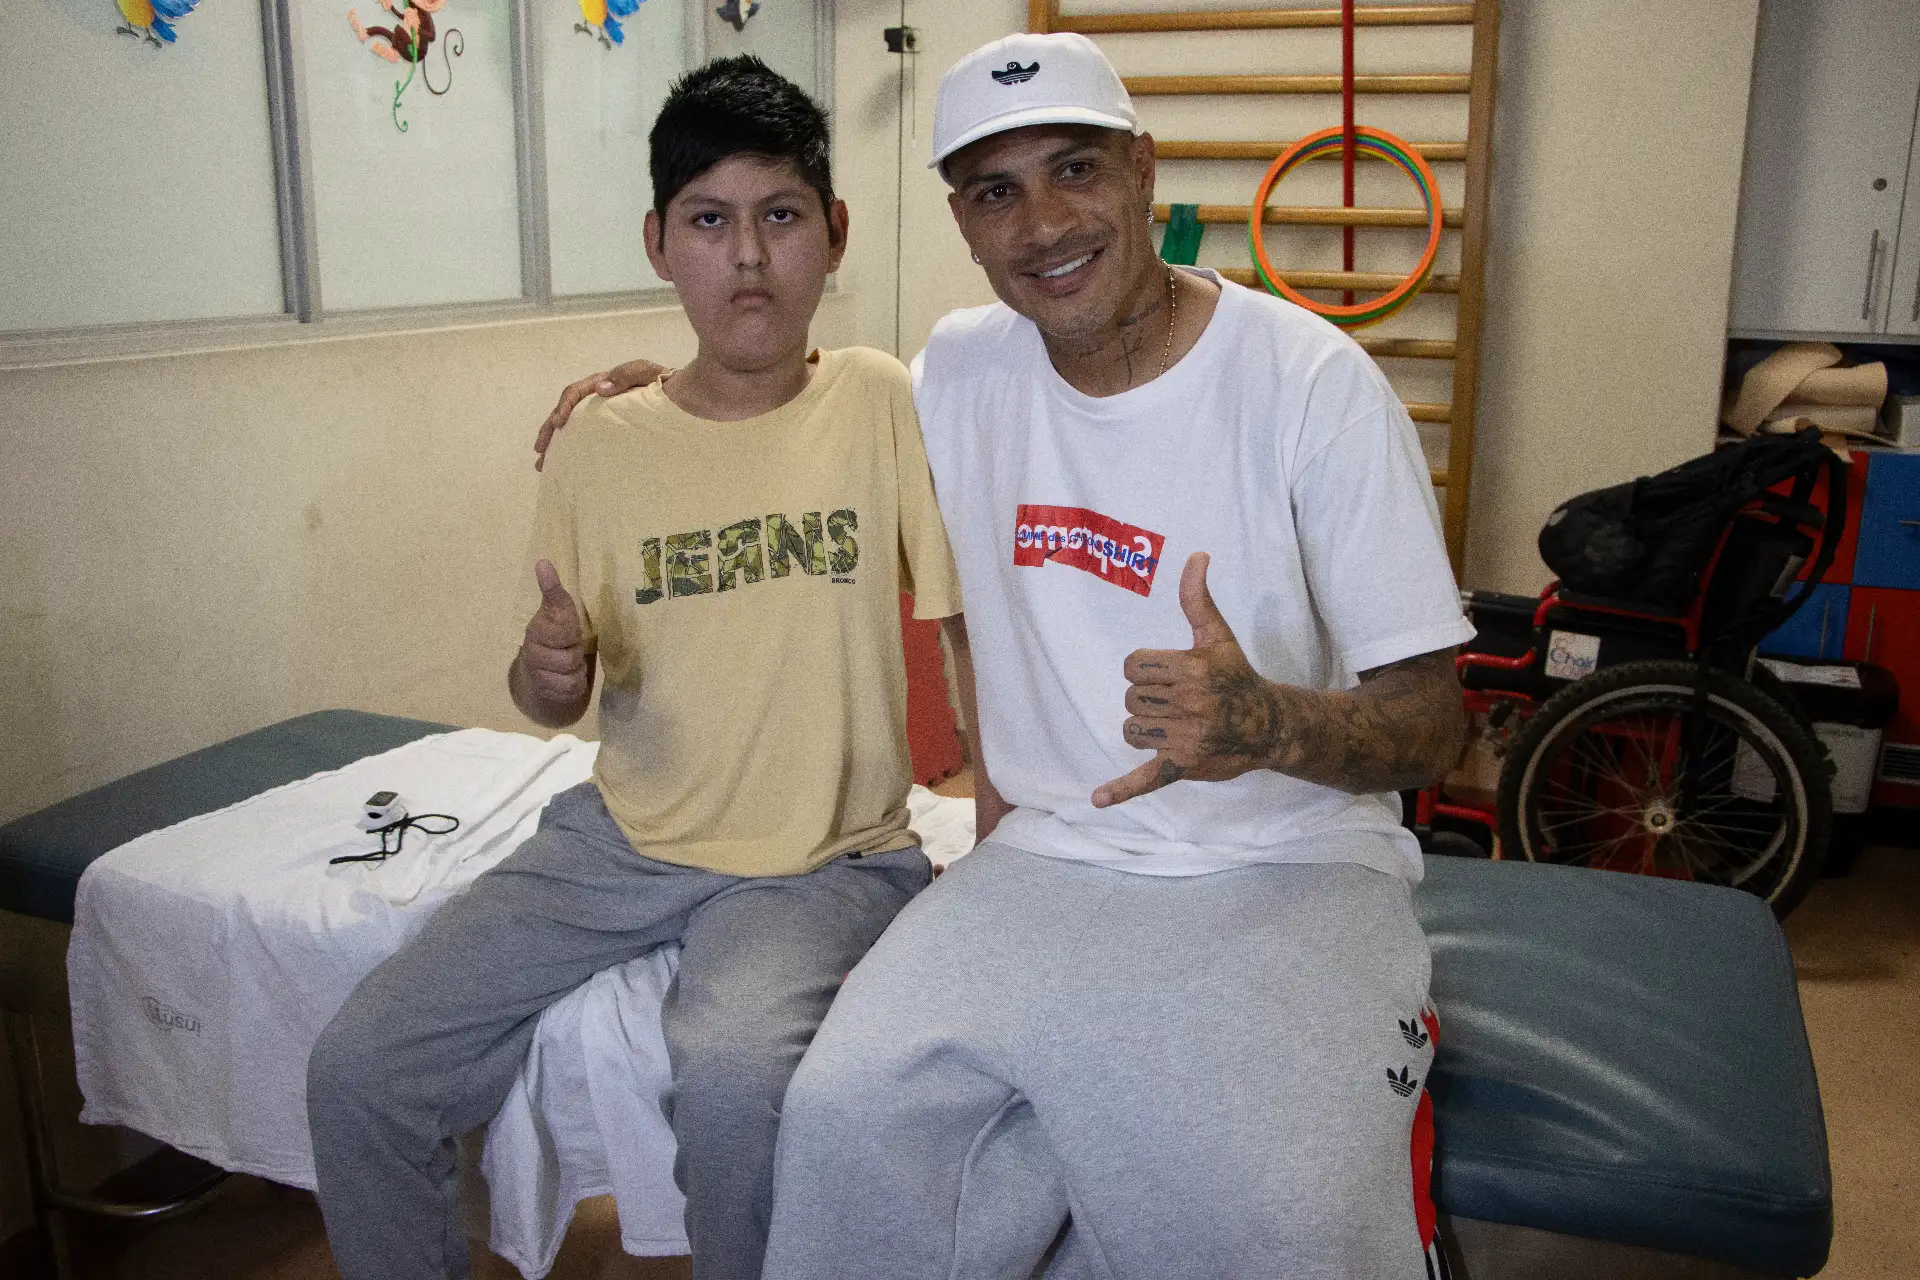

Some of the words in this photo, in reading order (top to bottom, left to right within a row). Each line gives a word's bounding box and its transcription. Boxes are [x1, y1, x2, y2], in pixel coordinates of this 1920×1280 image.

[635, 508, 859, 604] JEANS
[1102, 540, 1158, 574] SHIRT
[831, 577, 856, 585] BRONCO
